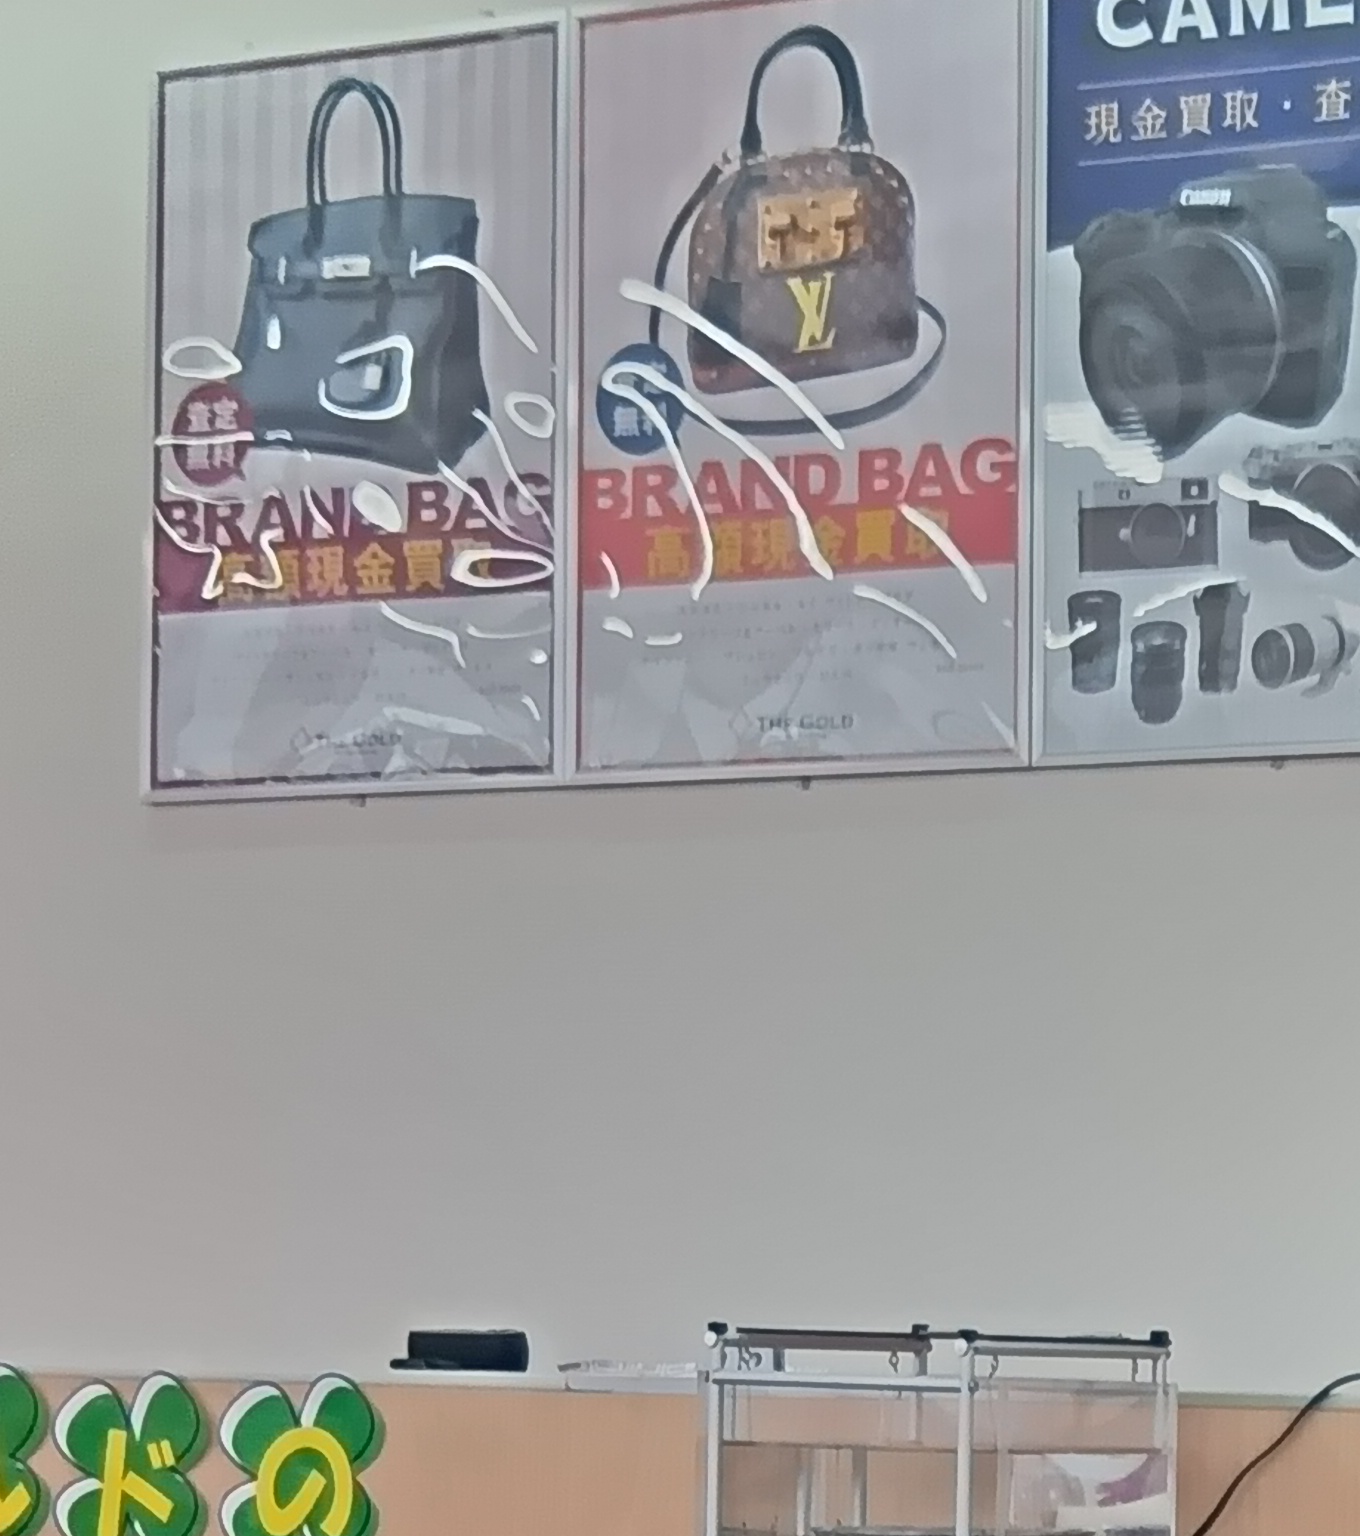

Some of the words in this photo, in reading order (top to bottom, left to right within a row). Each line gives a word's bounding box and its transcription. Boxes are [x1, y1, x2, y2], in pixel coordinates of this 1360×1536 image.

[583, 453, 841, 519] BRAND
[858, 438, 1017, 502] BAG
[160, 484, 398, 546] BRAN
